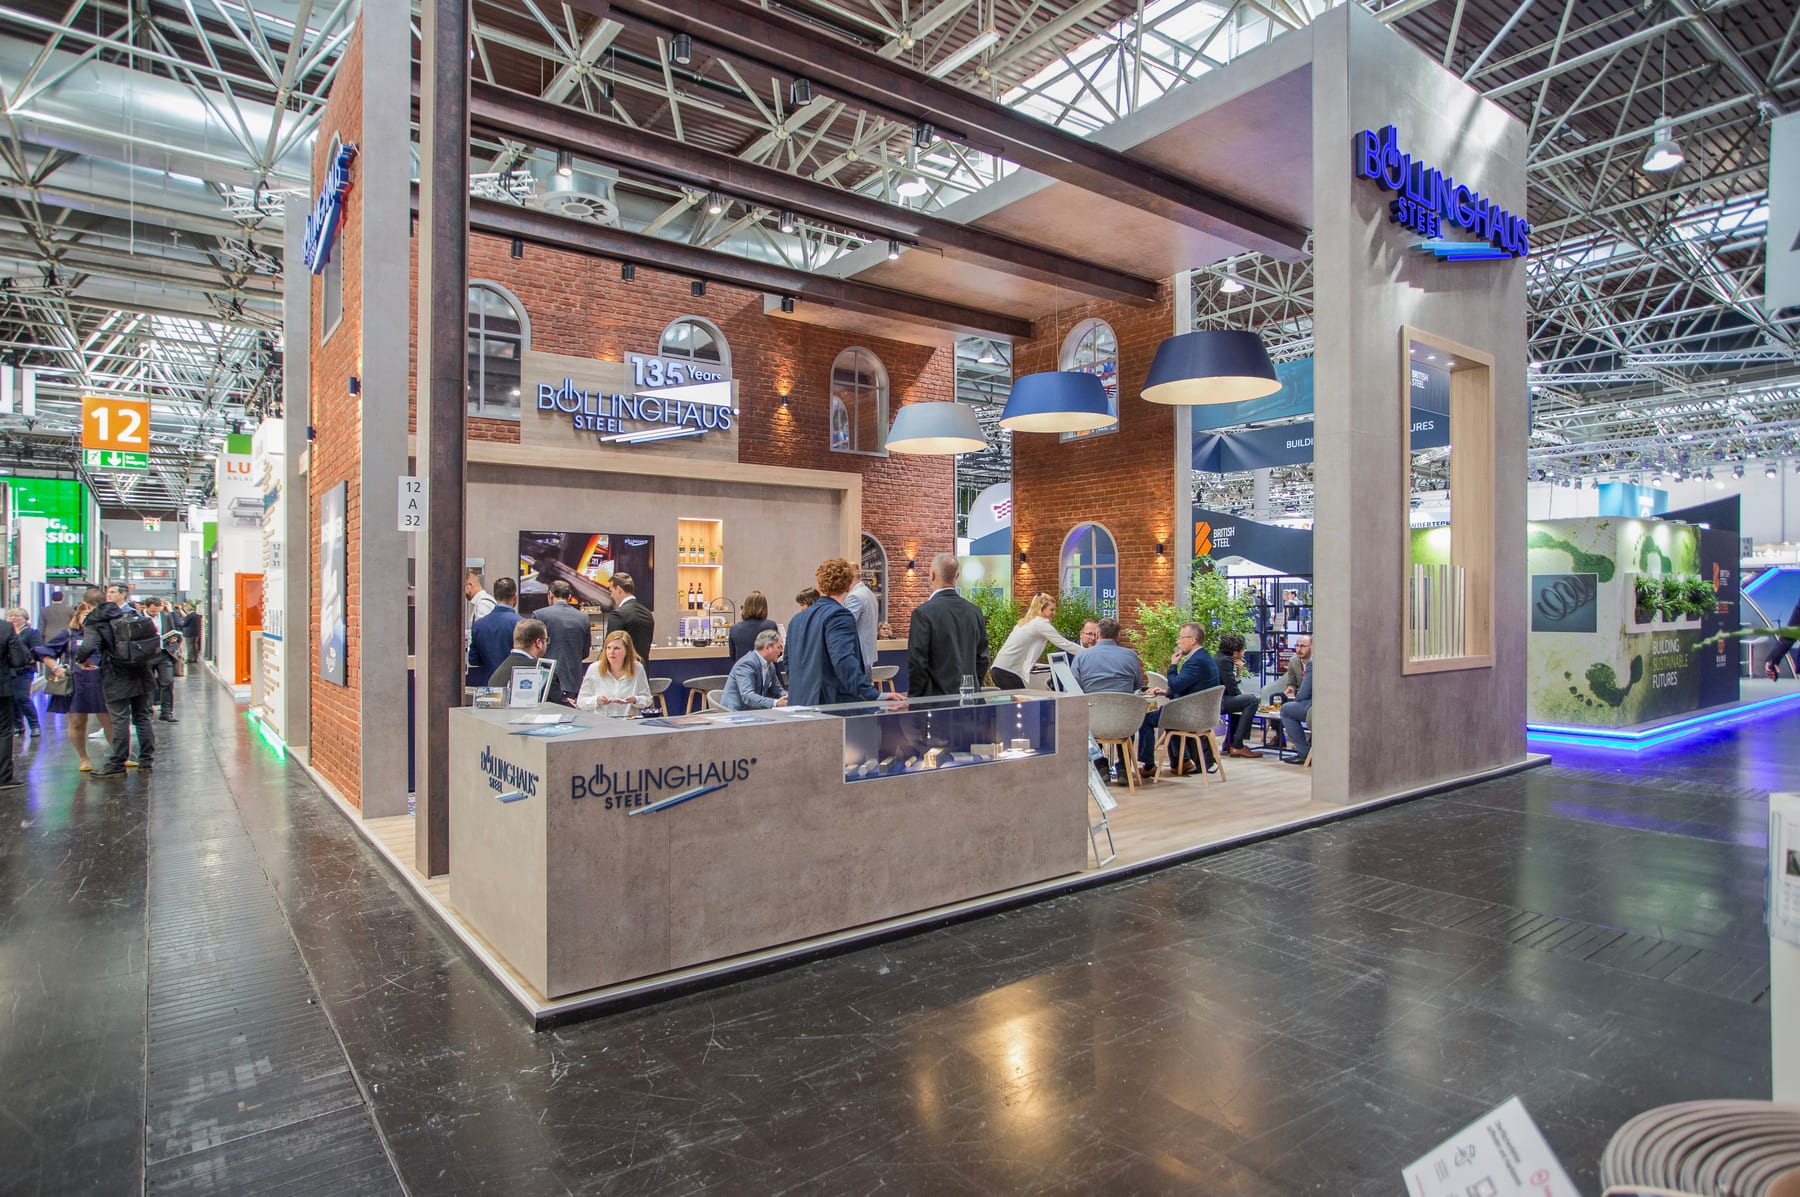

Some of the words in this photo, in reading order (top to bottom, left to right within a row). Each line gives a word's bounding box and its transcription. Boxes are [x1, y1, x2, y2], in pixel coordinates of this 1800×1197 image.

[1397, 196, 1444, 240] STEEL
[630, 356, 685, 387] 135
[686, 365, 722, 381] Years
[91, 407, 142, 444] 12
[574, 415, 625, 434] STEEL
[227, 461, 251, 474] LU
[405, 481, 421, 493] 12
[408, 498, 418, 510] A
[405, 514, 420, 526] 32
[1213, 526, 1235, 538] BRITISH
[1213, 538, 1230, 548] STEEL
[1103, 588, 1116, 598] BU
[1652, 639, 1680, 655] BUILDING
[1653, 653, 1689, 672] SUSTAINABLE
[1652, 672, 1679, 689] FUTURES
[489, 776, 503, 794] STEEL
[605, 794, 652, 810] STEEL
